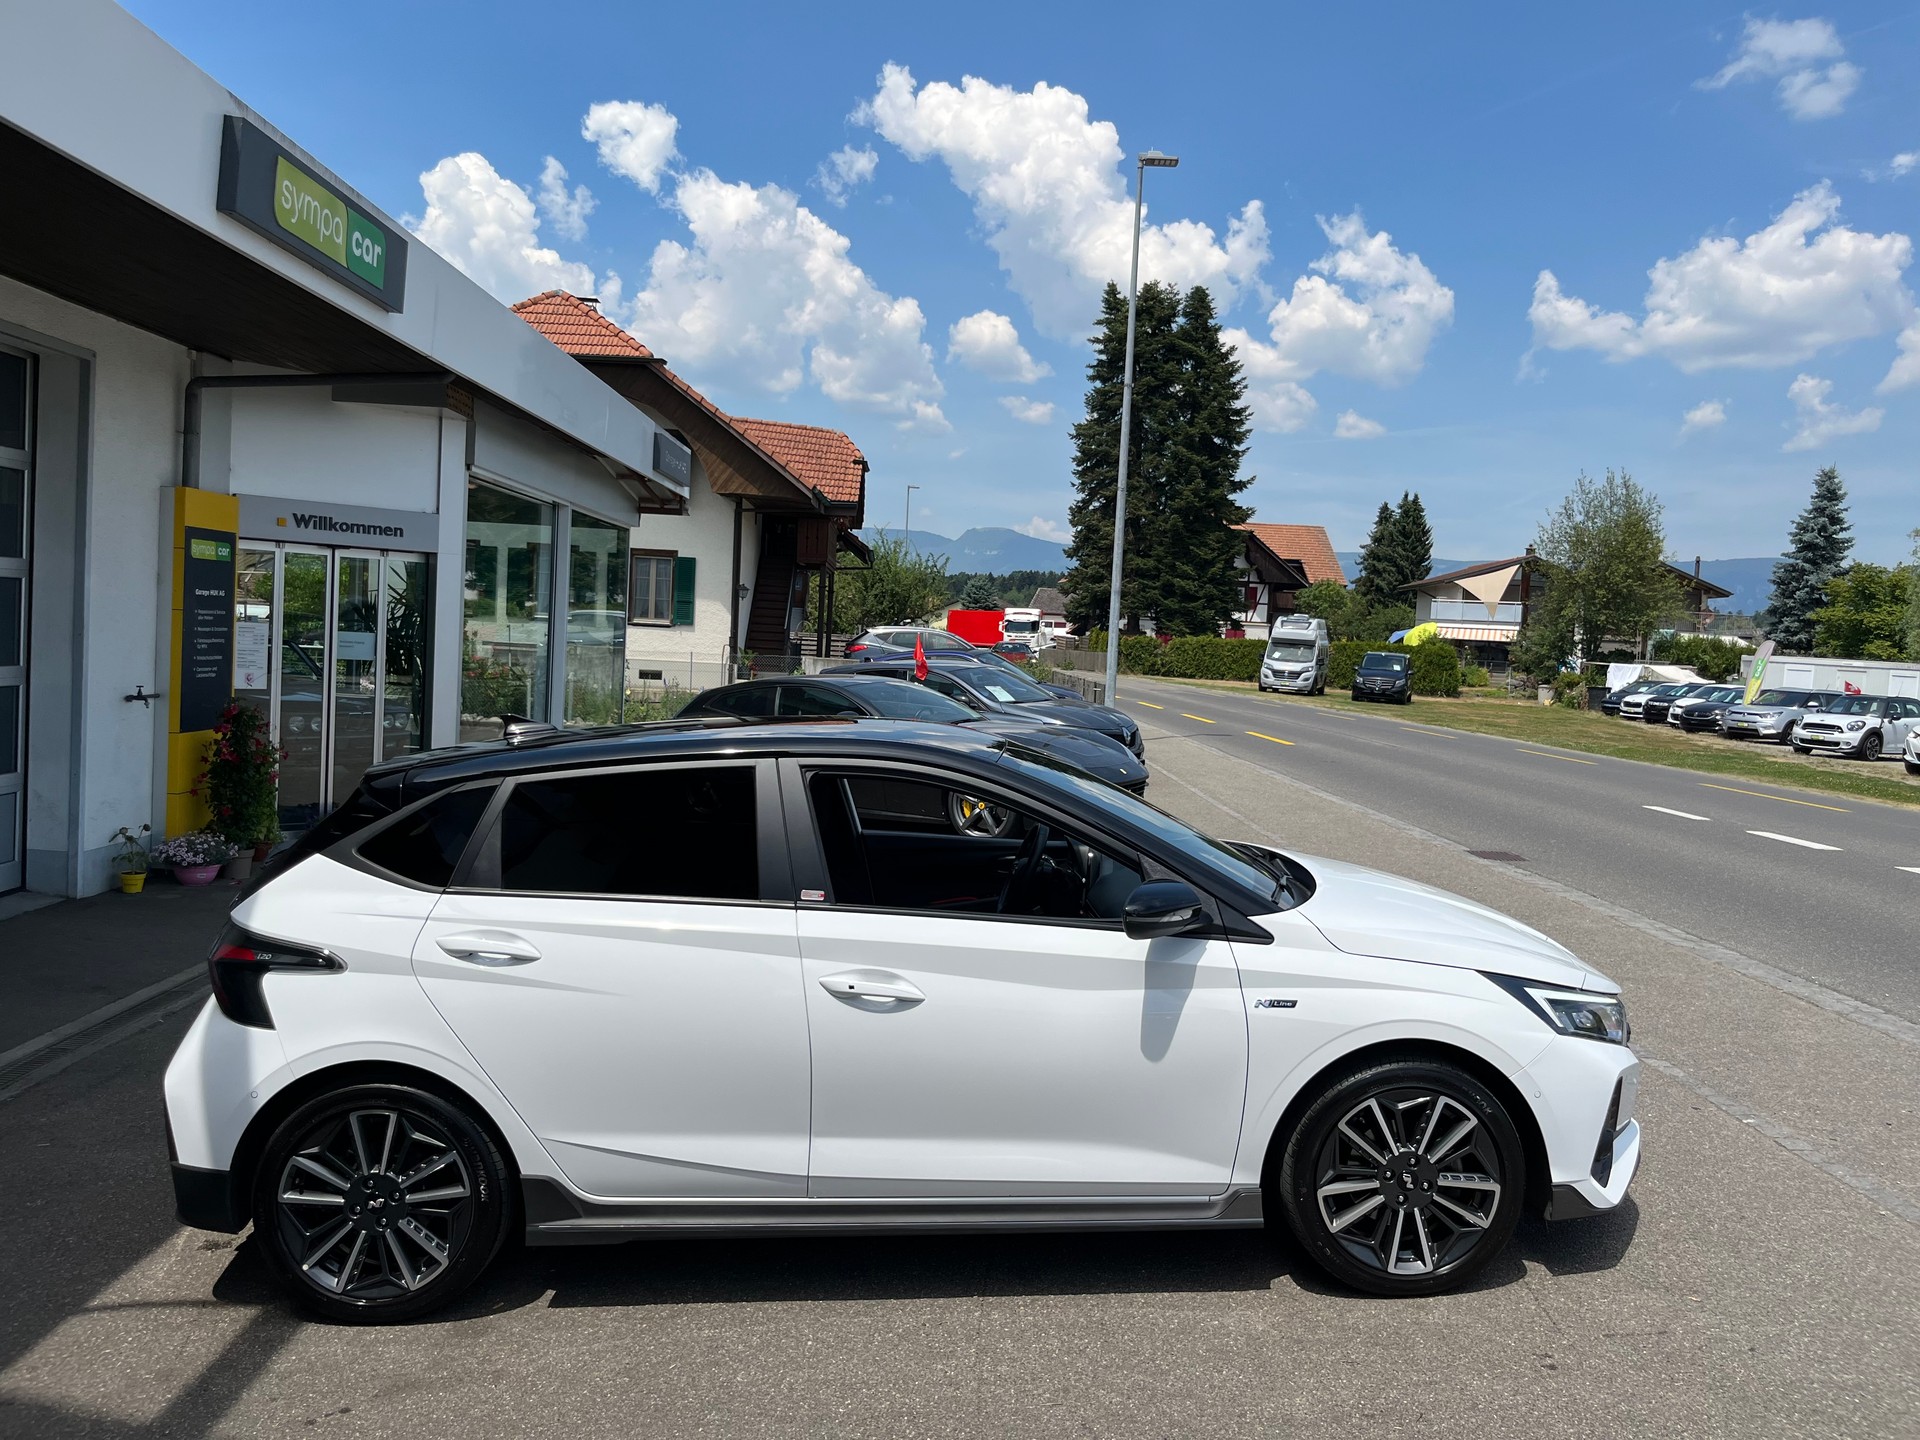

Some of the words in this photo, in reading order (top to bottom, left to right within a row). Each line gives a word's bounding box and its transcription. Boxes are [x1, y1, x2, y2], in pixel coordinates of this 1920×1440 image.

[281, 180, 343, 245] sympa
[351, 231, 382, 268] car
[293, 513, 404, 538] Willkommen
[192, 544, 216, 556] sympa
[217, 547, 230, 557] car
